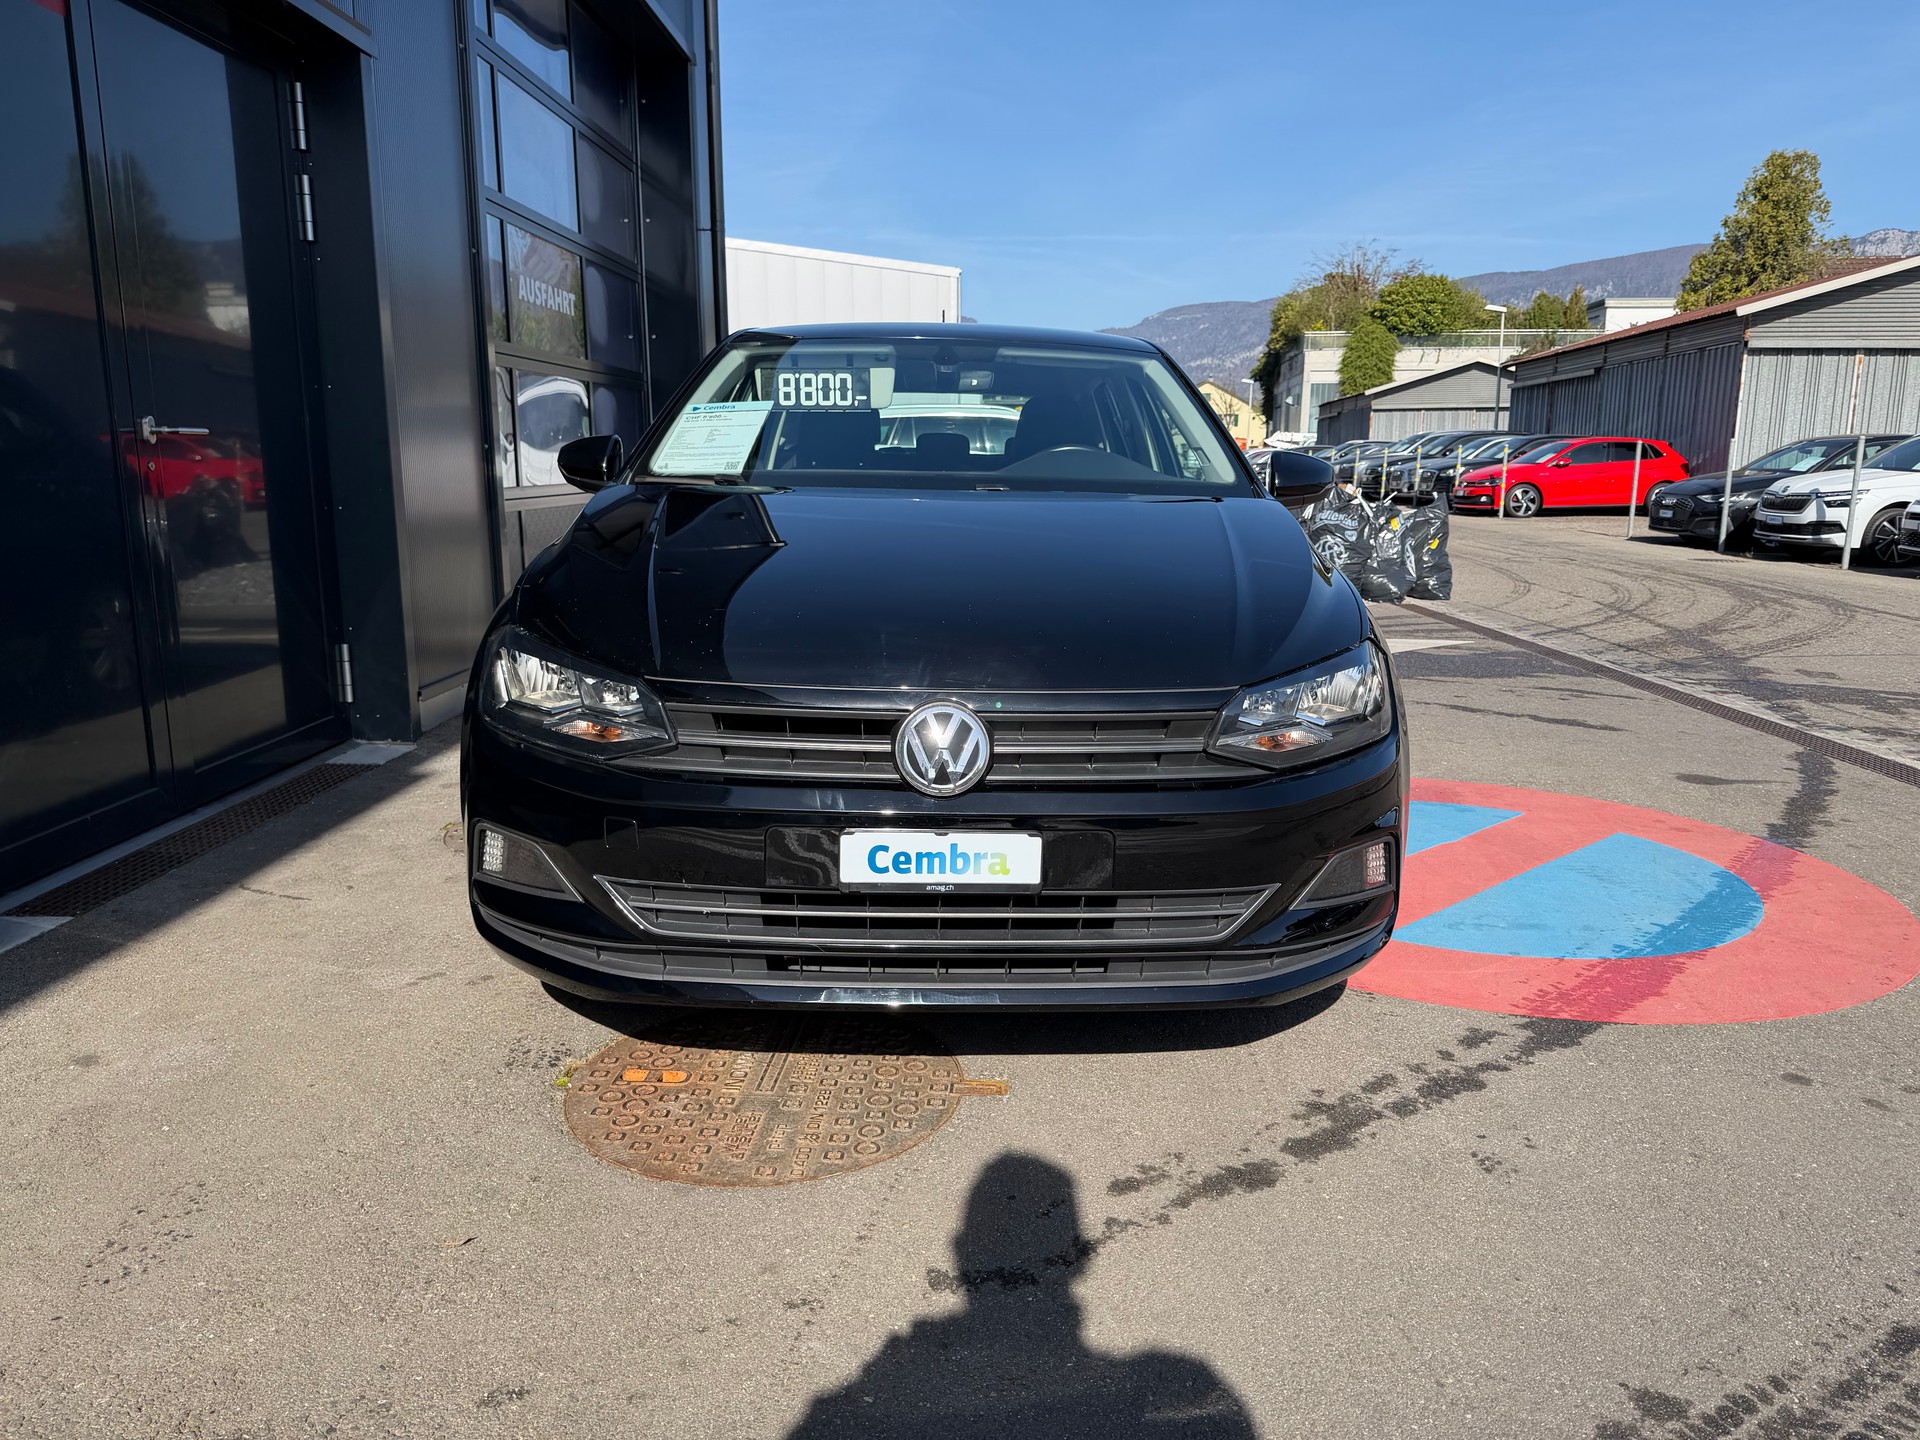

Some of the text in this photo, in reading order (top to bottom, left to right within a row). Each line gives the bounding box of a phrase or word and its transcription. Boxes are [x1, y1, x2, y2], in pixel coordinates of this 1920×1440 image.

[518, 274, 576, 317] AUSFAHRT
[900, 706, 986, 792] VW
[868, 843, 1010, 875] Cembra
[926, 884, 955, 892] amag.ch
